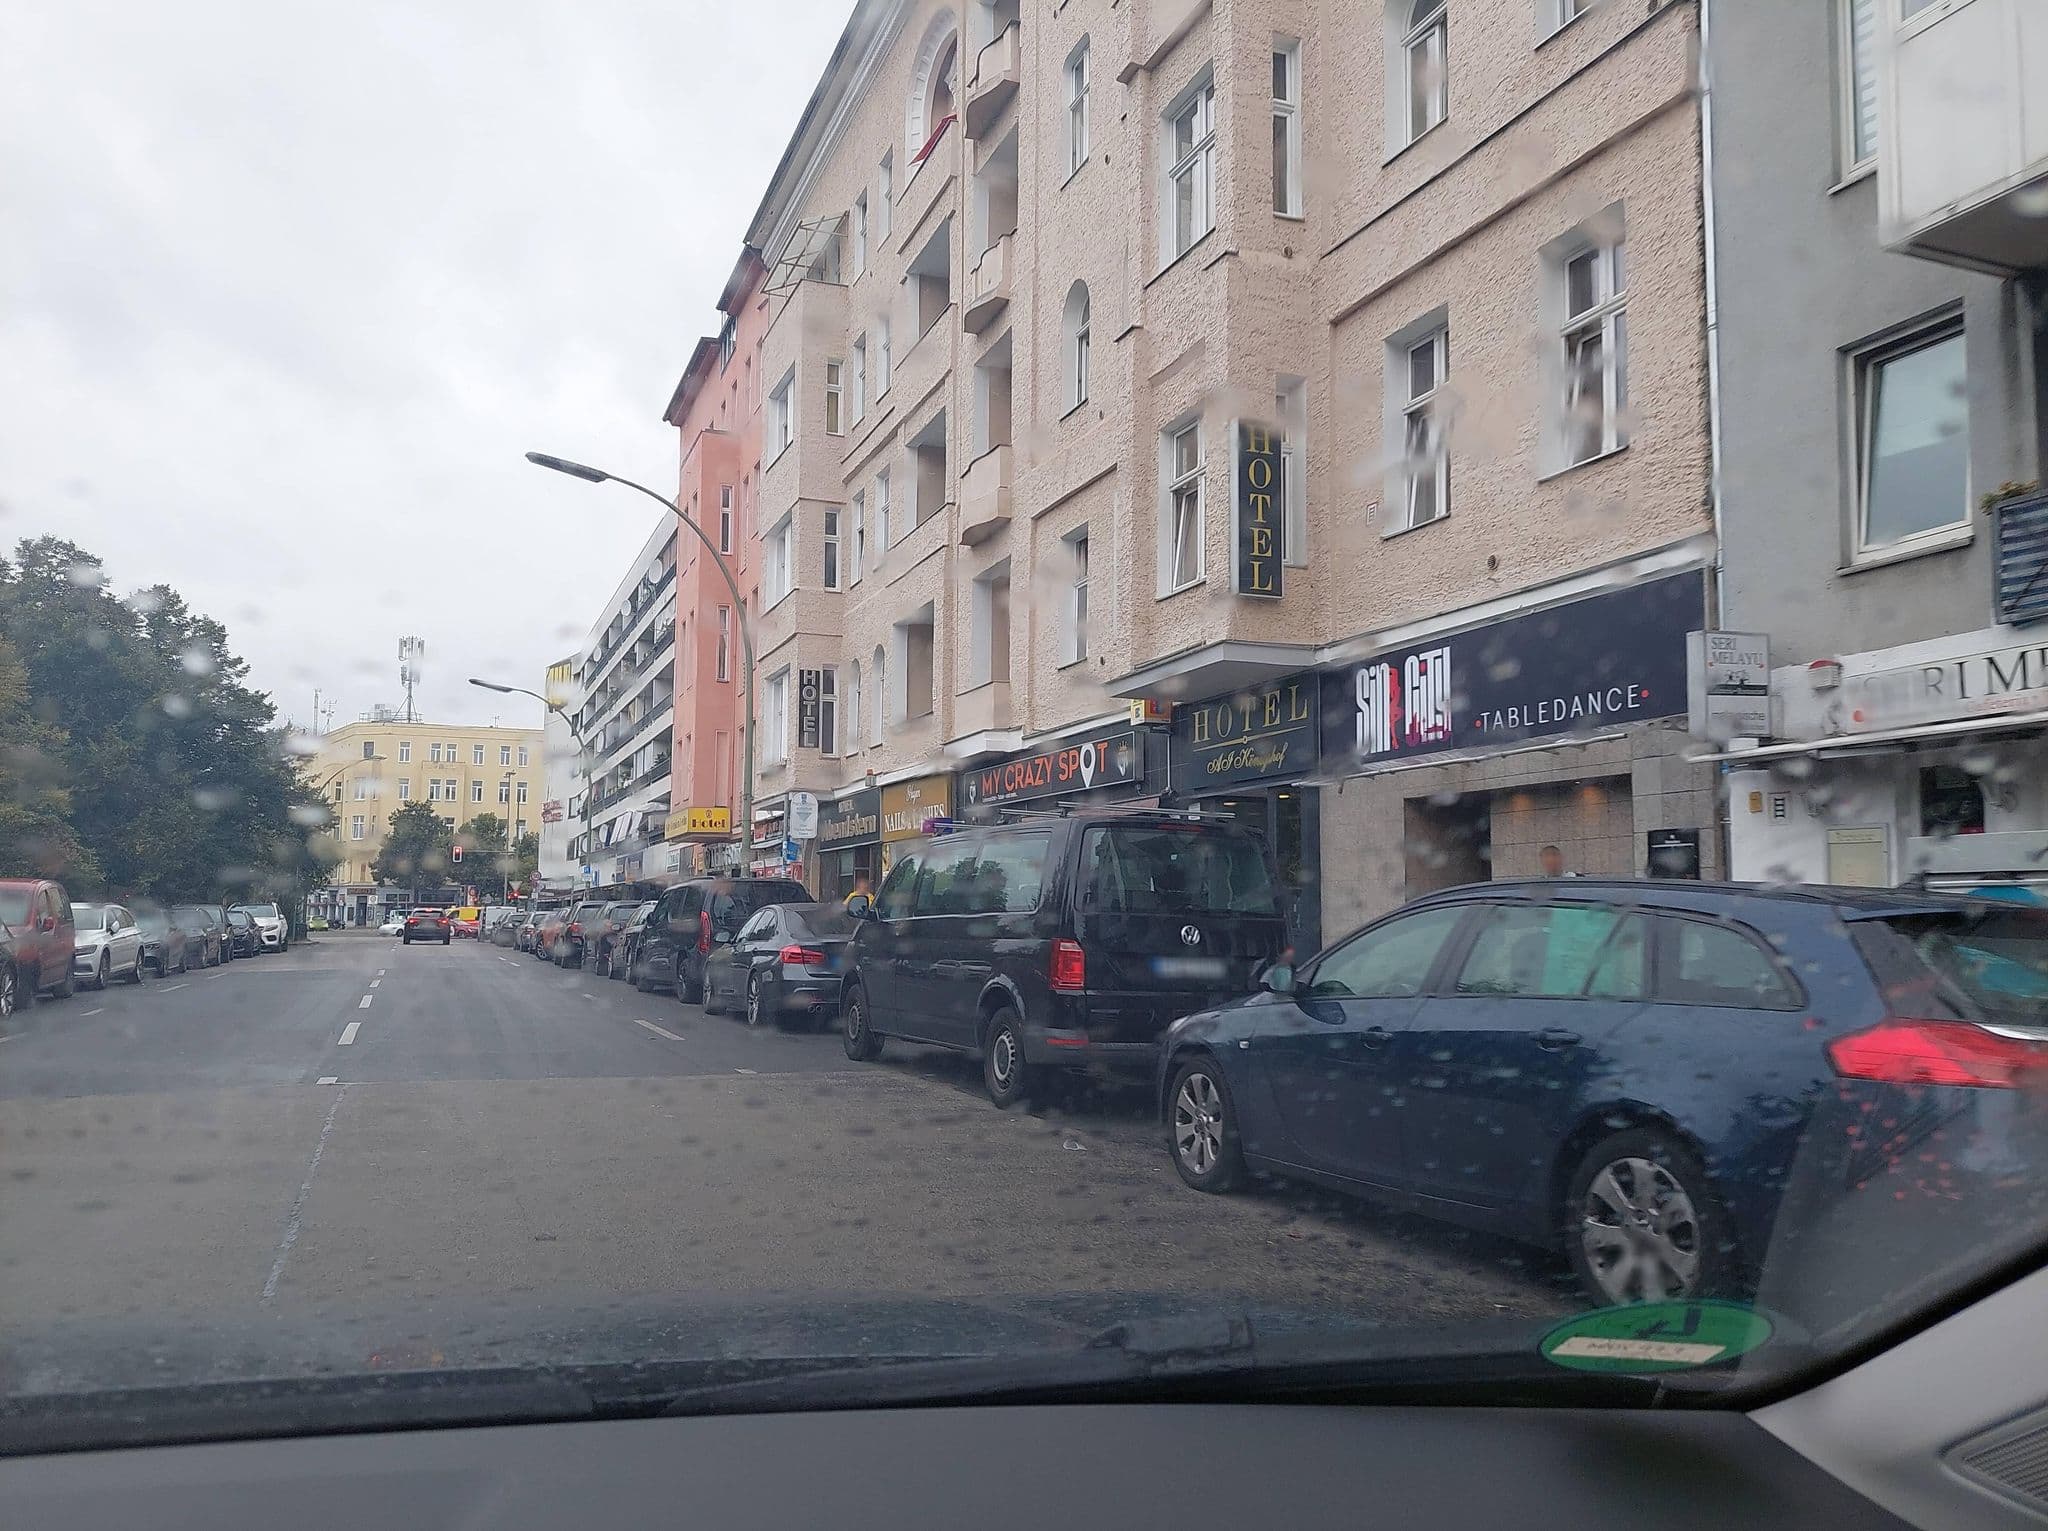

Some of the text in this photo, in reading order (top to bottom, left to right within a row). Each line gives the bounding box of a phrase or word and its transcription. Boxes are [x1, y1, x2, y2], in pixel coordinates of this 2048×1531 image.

[1246, 424, 1273, 591] HOTEL
[802, 669, 817, 748] HOTEL
[1191, 685, 1308, 743] HOTEL
[1480, 684, 1640, 733] TABLEDANCE
[981, 743, 1108, 795] MY CRAZY SPOT
